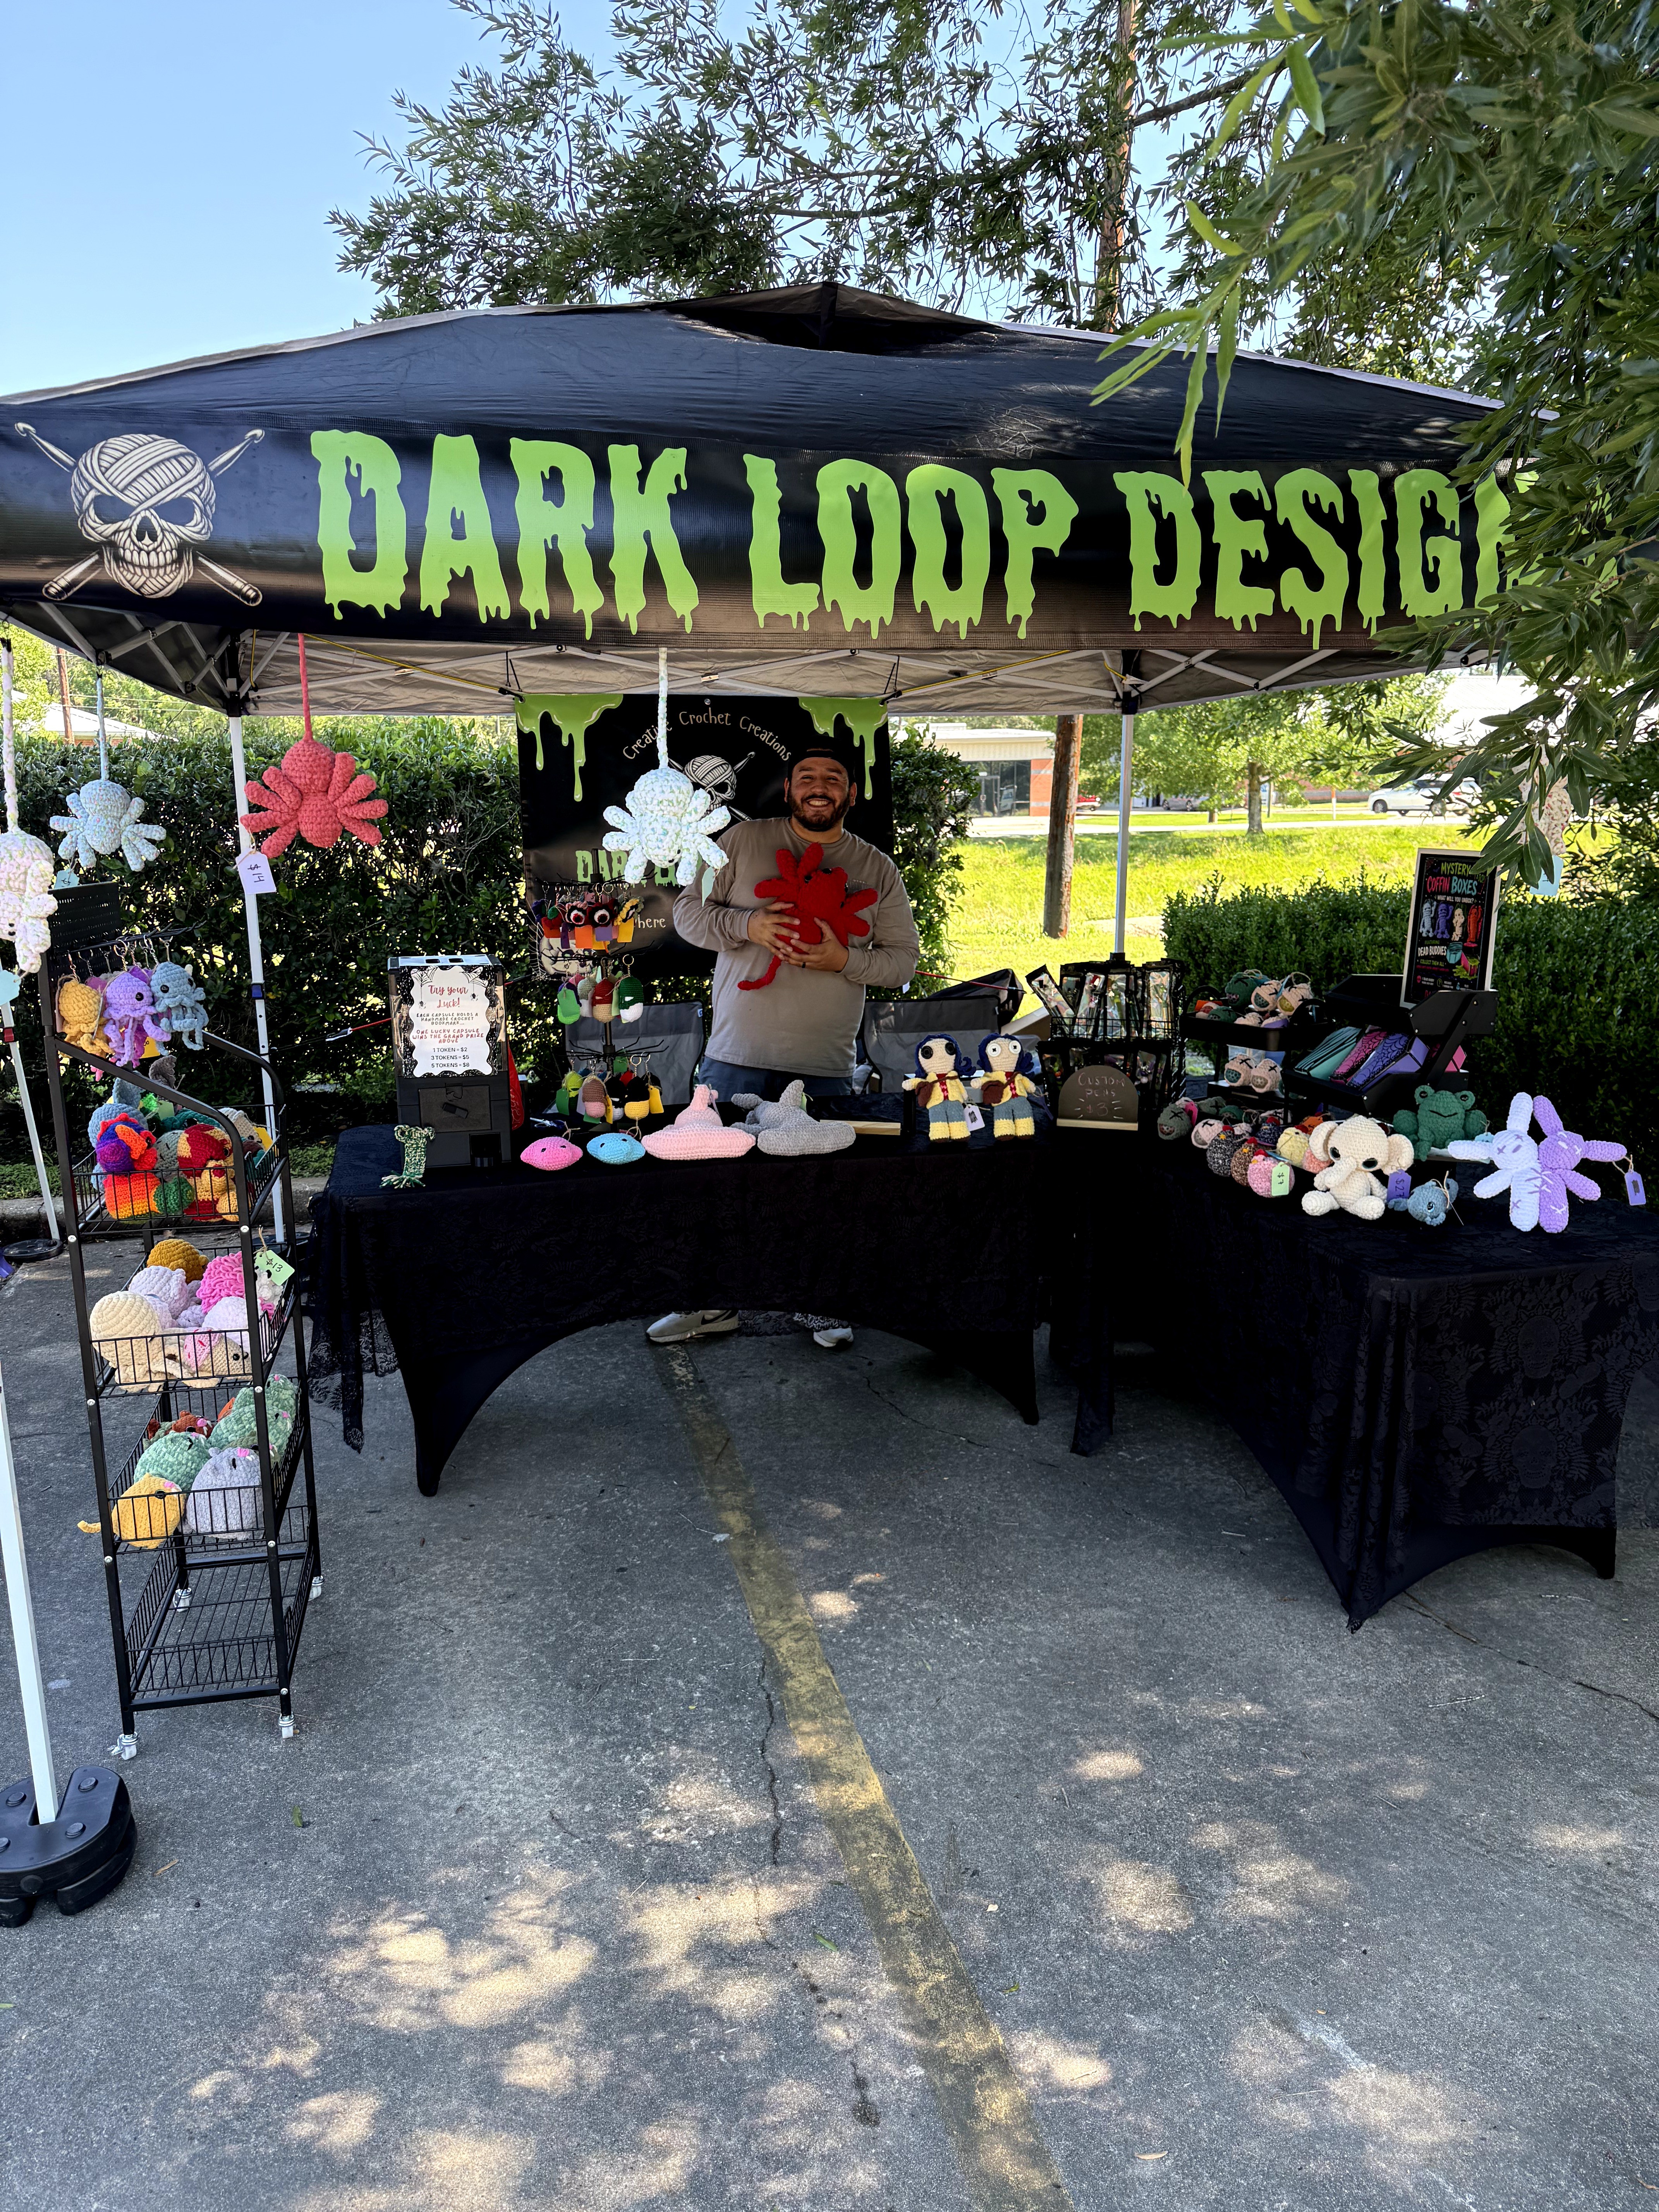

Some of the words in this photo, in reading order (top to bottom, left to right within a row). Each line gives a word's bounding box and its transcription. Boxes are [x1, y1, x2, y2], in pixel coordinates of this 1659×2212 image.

[311, 429, 699, 640] DARK
[742, 453, 1079, 640] LOOP
[623, 721, 672, 759] Creatie
[679, 707, 732, 726] Crochet
[740, 716, 792, 761] Creations
[247, 864, 264, 882] $14
[575, 850, 647, 888] DAR
[1441, 862, 1471, 877] MYSTERY
[1427, 876, 1451, 893] COFFIN
[1451, 876, 1478, 896] BOXES
[1418, 946, 1429, 957] DEAD
[1429, 946, 1447, 956] BUDDIES
[428, 985, 445, 995] Try
[447, 987, 469, 995] your
[437, 998, 460, 1008] Luck!
[1085, 1089, 1115, 1098] PENS
[1278, 1172, 1285, 1184] $7
[1395, 1178, 1404, 1197] $27
[266, 1258, 283, 1272] $13
